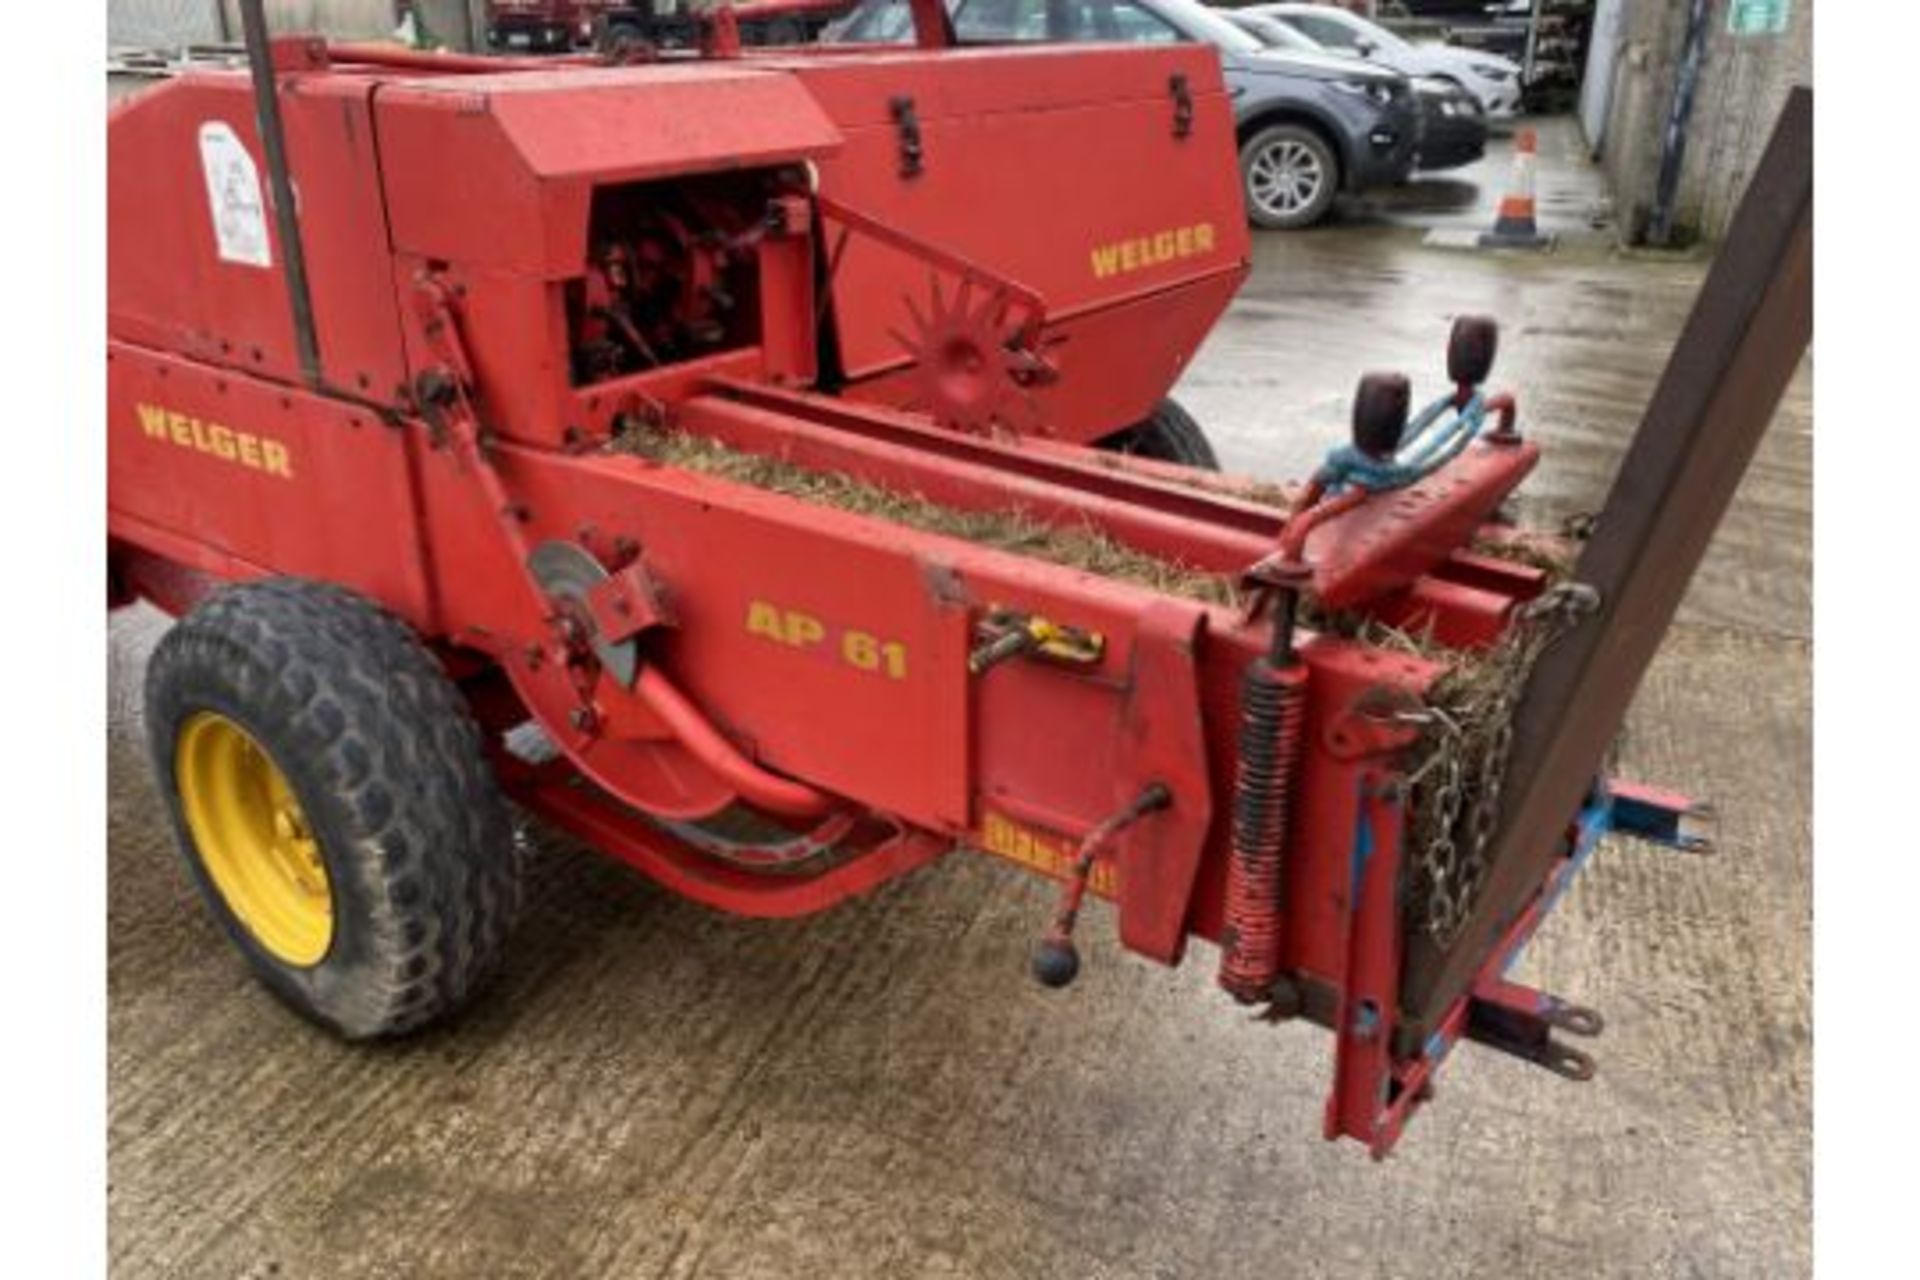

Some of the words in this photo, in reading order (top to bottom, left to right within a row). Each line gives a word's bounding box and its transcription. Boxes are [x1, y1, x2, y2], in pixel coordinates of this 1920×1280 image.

[1091, 222, 1215, 278] WELGER
[136, 402, 294, 479] WELGER
[746, 599, 825, 648] AP
[843, 628, 907, 680] 61
